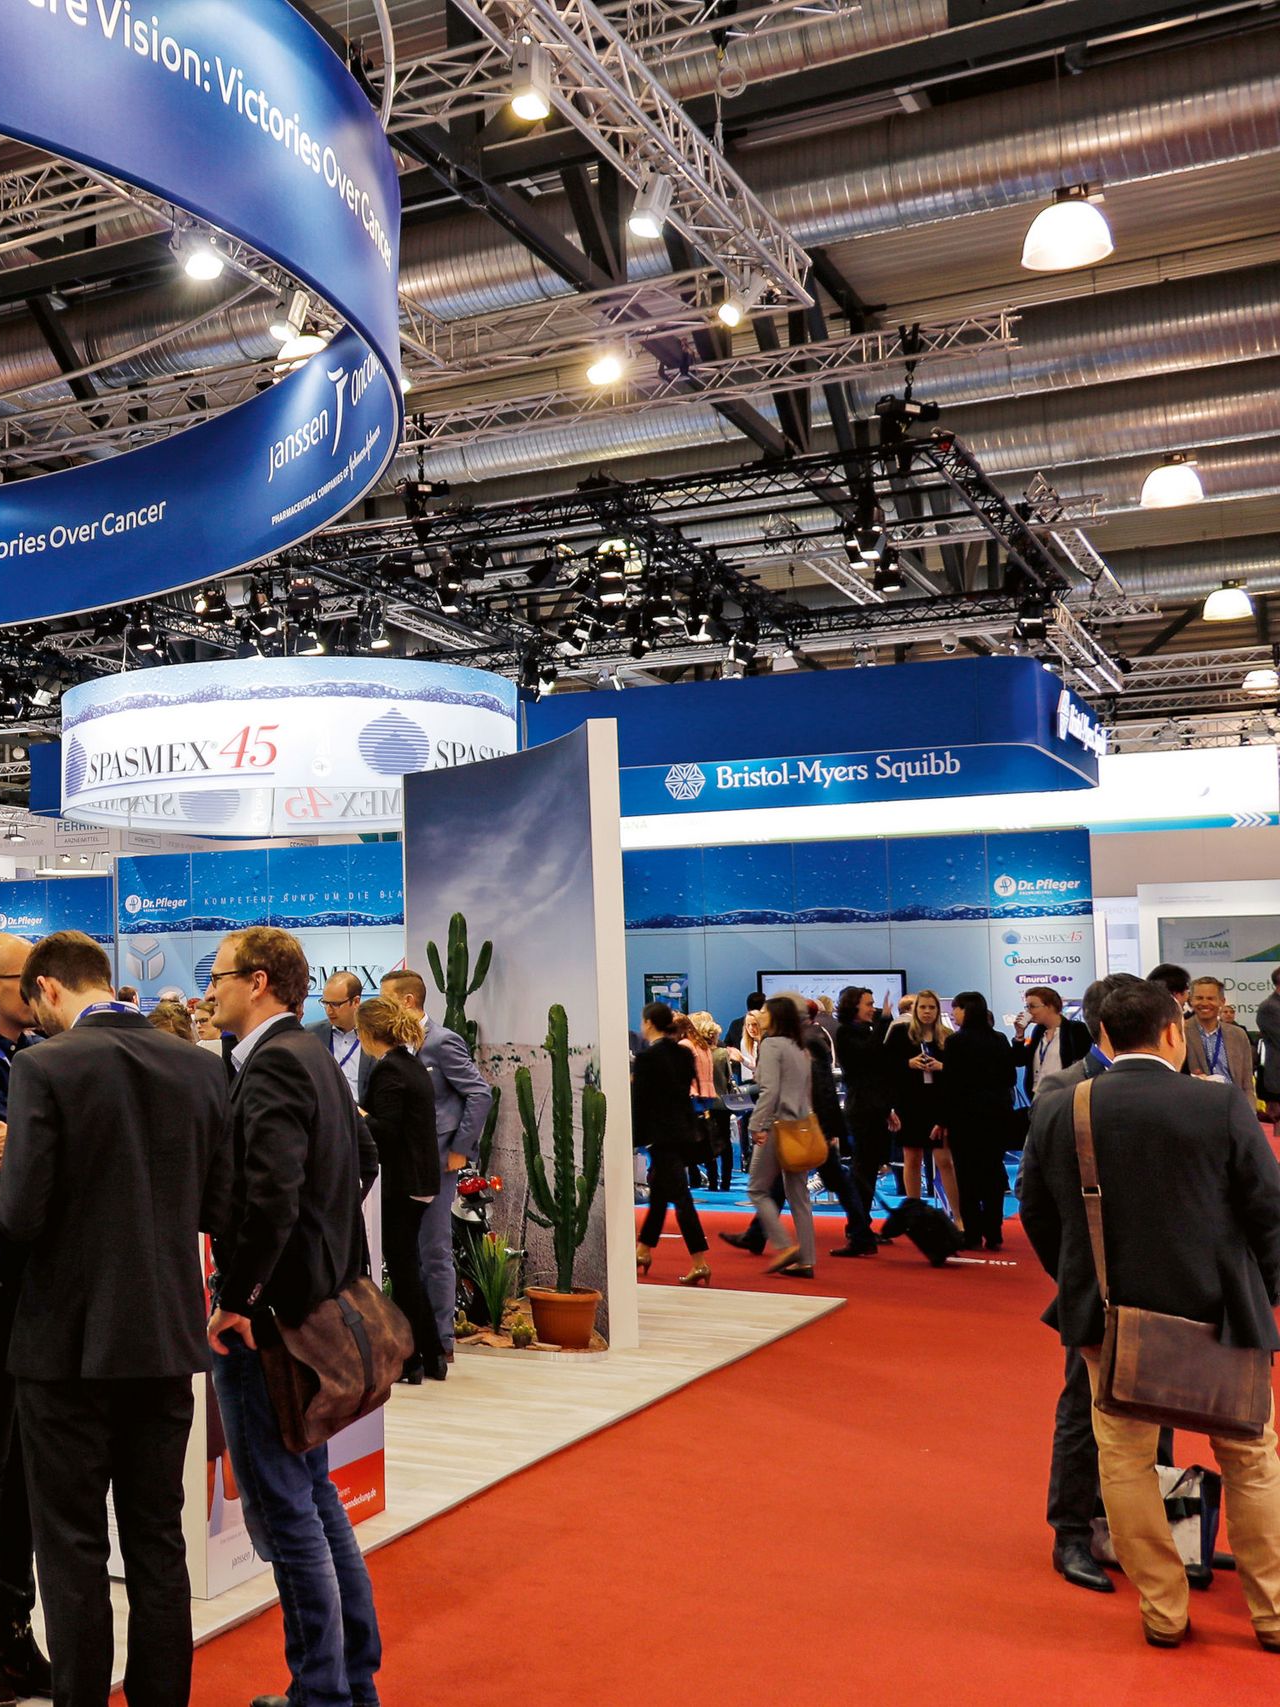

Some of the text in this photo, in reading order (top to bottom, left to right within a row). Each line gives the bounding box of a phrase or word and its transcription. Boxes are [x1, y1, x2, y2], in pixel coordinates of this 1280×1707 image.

[96, 0, 392, 272] Vision: Victories Over Cancer
[271, 490, 317, 526] PHARMACEUTICAL
[317, 471, 343, 500] COMPANIES
[342, 466, 350, 478] OF
[50, 521, 99, 548] Over
[101, 500, 167, 537] Cancer
[219, 724, 280, 770] 45
[715, 751, 961, 791] Bristol-Myers Squibb
[204, 895, 274, 906] KOMPETENZ
[284, 894, 316, 903] RUND
[324, 892, 339, 900] UM
[349, 891, 370, 900] DIE
[1012, 955, 1081, 965] Bicalutin 50/150
[1184, 941, 1229, 949] JEVTANA
